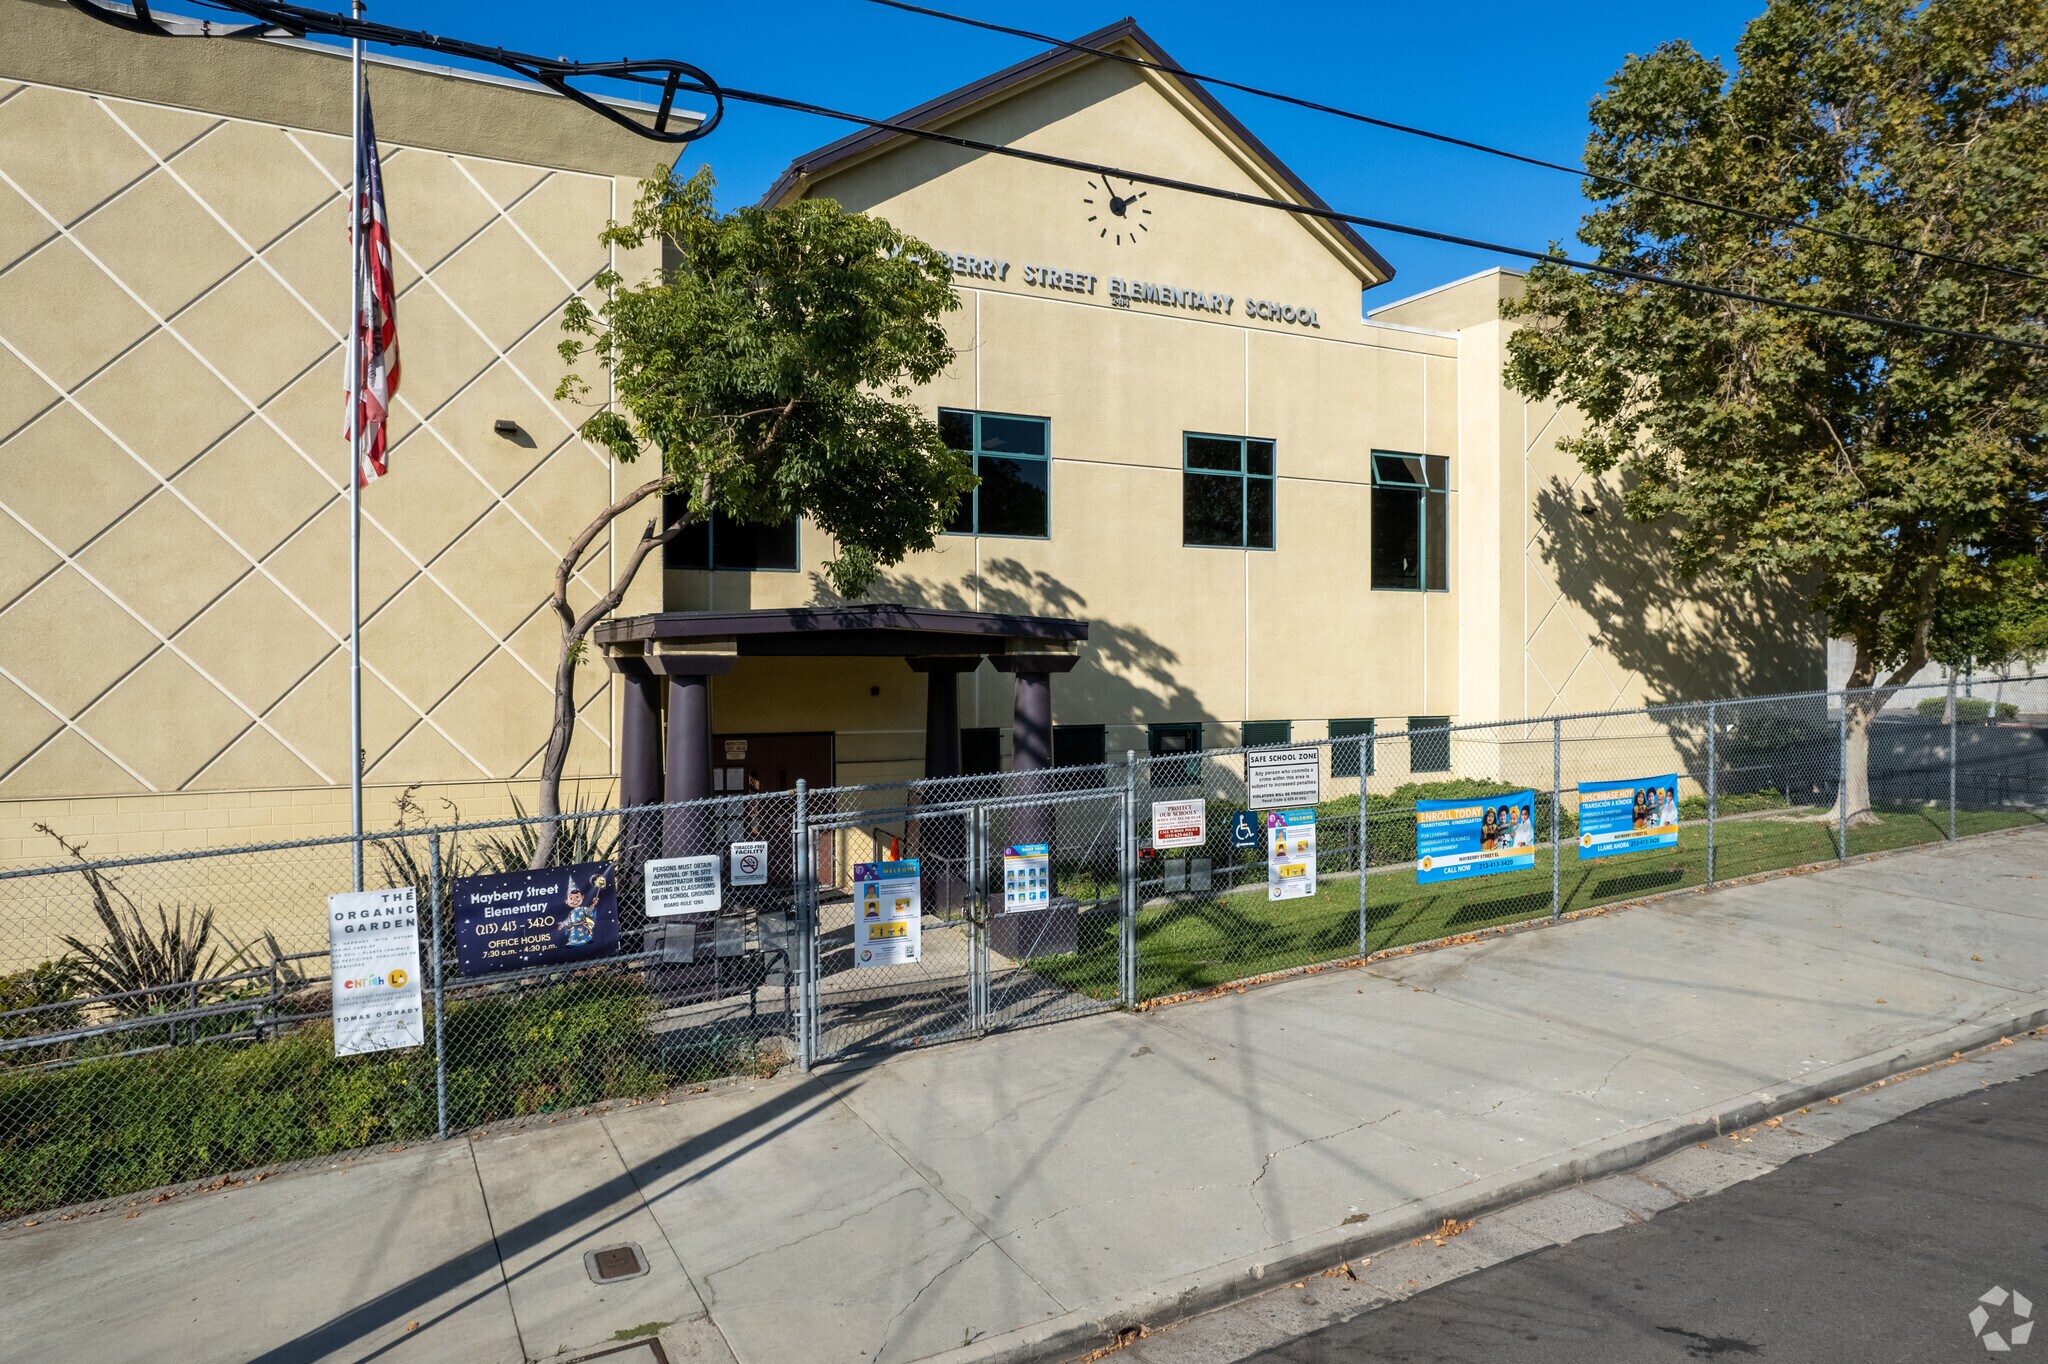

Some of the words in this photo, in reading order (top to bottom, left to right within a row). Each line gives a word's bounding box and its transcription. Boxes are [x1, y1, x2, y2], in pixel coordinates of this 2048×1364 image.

[1024, 264, 1096, 295] STREET
[1108, 276, 1233, 314] ELEMENTARY
[1246, 298, 1320, 328] SCHOOL
[1620, 790, 1633, 798] HOY
[1583, 802, 1611, 810] TRANSICIÓN
[1421, 810, 1453, 822] ENROLL
[1455, 808, 1481, 819] TODAY
[1452, 818, 1482, 826] KINDERGARTEN
[1431, 845, 1458, 853] ENVIRONMENT
[1479, 860, 1513, 869] 213-413-3420
[652, 878, 693, 887] ADMINISTRATOR
[654, 872, 680, 880] APPROVAL
[681, 883, 715, 891] CLASSROOMS
[382, 892, 413, 902] THE
[471, 890, 523, 905] Mayberry
[527, 884, 559, 897] Street
[335, 906, 414, 921] ORGANIC
[485, 902, 548, 918] Elementary
[345, 919, 415, 933] GARDEN
[476, 922, 498, 936] (213)
[501, 920, 517, 932] 413
[527, 916, 555, 929] 3420
[488, 938, 519, 948] OFFICE
[521, 934, 551, 945] HOURS
[482, 951, 500, 959] 7:30
[524, 945, 540, 953] 4:30
[542, 944, 557, 952] p.m.
[337, 1014, 370, 1023] TOMAS
[376, 1008, 420, 1018] O'GRADY
